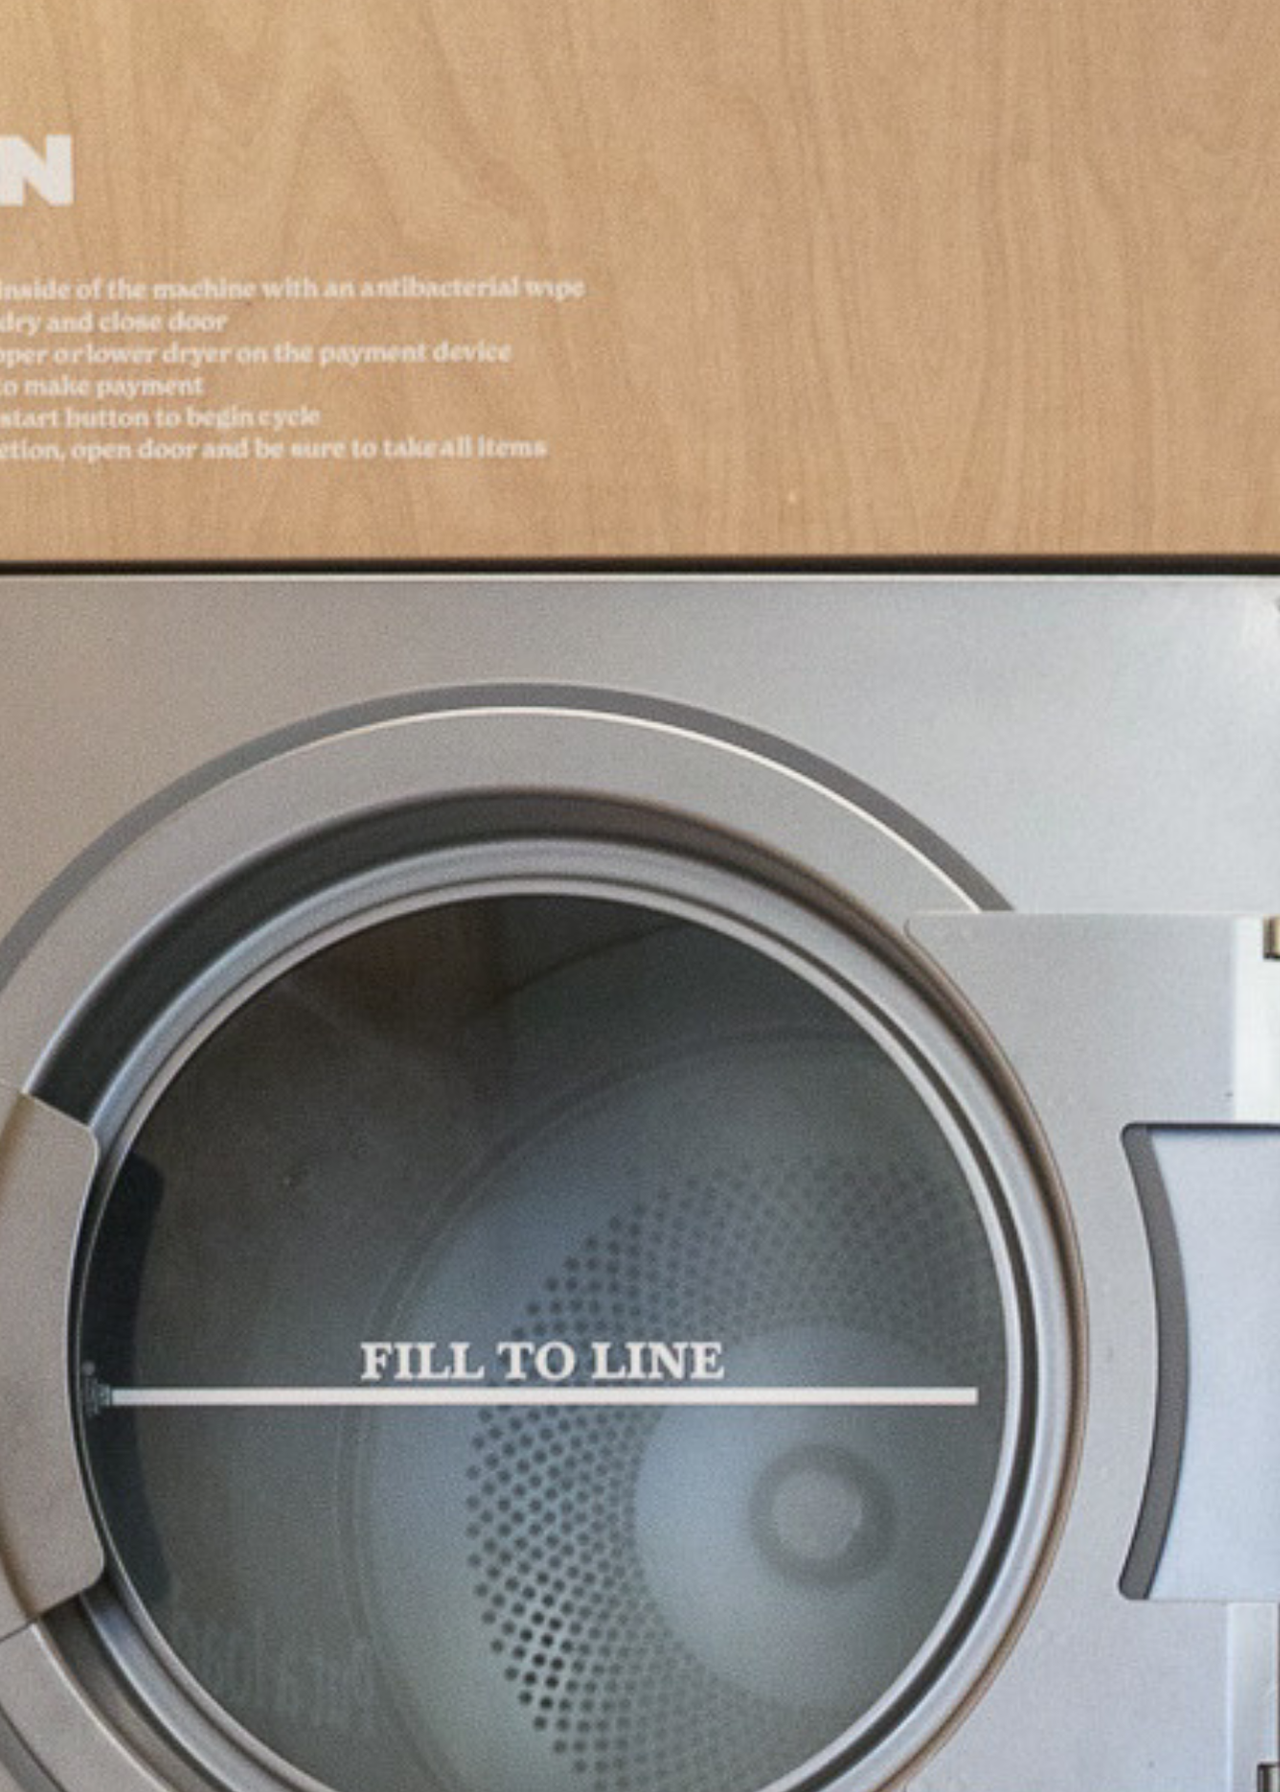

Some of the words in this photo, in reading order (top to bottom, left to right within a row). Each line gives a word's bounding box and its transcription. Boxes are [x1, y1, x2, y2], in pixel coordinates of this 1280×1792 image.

[0, 278, 70, 299] nside
[75, 277, 102, 299] of
[106, 277, 146, 299] the
[153, 277, 257, 299] machine
[261, 277, 318, 298] with
[324, 282, 356, 298] an
[361, 276, 519, 298] antibacterial
[525, 277, 586, 301] wipe
[46, 311, 94, 333] and
[100, 311, 162, 333] close
[168, 310, 229, 332] door
[53, 349, 82, 363] or
[85, 342, 158, 363] lower
[162, 341, 234, 367] dryer
[236, 348, 268, 363] on
[273, 341, 313, 363] the
[319, 344, 426, 367] payment
[432, 340, 512, 362] device
[24, 375, 89, 397] make
[96, 377, 205, 399] payment
[64, 406, 150, 428] button
[155, 409, 182, 428] to
[187, 405, 254, 429] begin
[258, 406, 321, 430] cycle
[361, 1342, 485, 1382] FILL
[497, 1342, 577, 1382] TO
[592, 1342, 726, 1382] LINE
